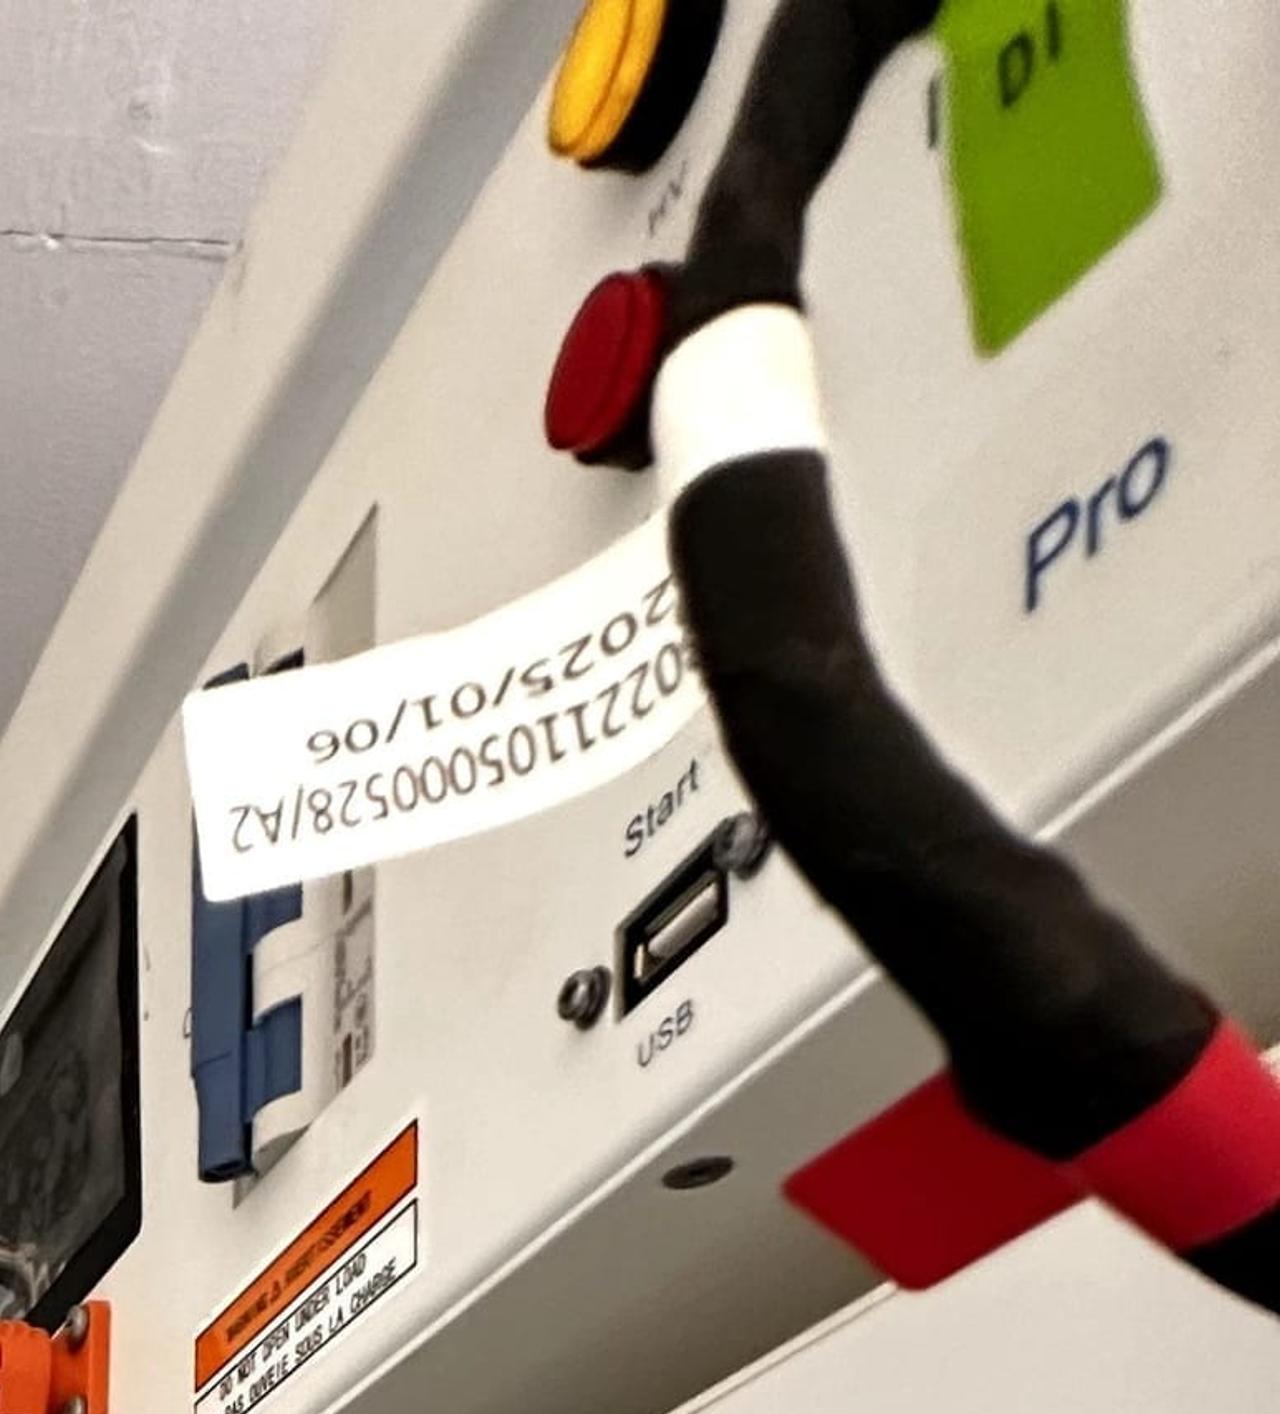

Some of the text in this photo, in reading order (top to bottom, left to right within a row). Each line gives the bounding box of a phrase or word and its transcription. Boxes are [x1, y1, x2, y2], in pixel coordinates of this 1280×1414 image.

[1024, 436, 1169, 613] Pro
[229, 640, 698, 854] 0221105000528/A2
[307, 574, 676, 765] 2025/01/06
[623, 758, 701, 860] Start
[636, 997, 696, 1070] USB
